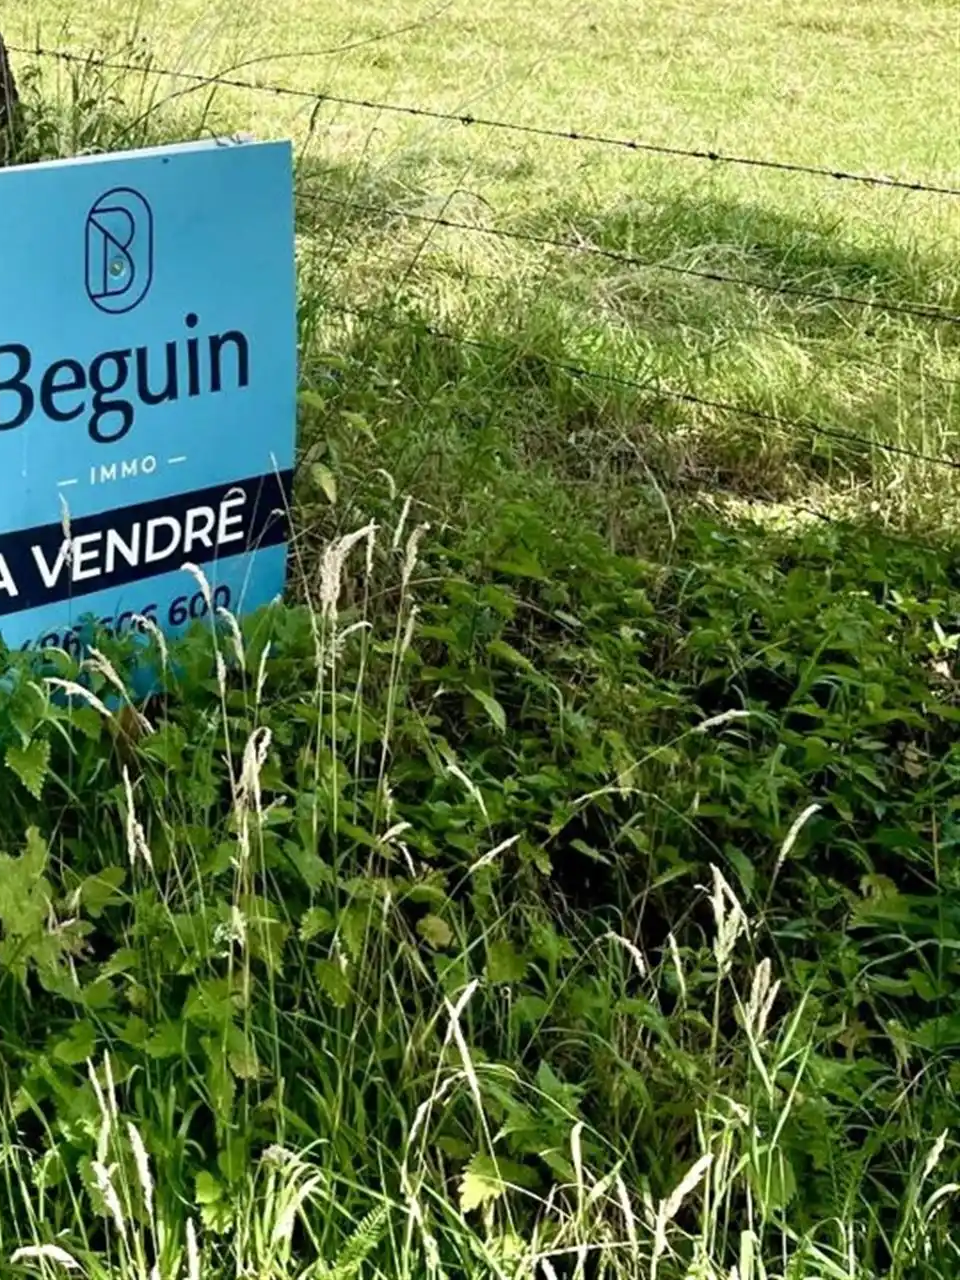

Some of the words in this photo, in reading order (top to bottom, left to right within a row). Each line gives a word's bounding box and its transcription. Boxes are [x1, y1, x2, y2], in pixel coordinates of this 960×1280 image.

[89, 455, 157, 484] IMMO
[31, 498, 246, 588] VENDRE
[168, 584, 231, 626] 600
